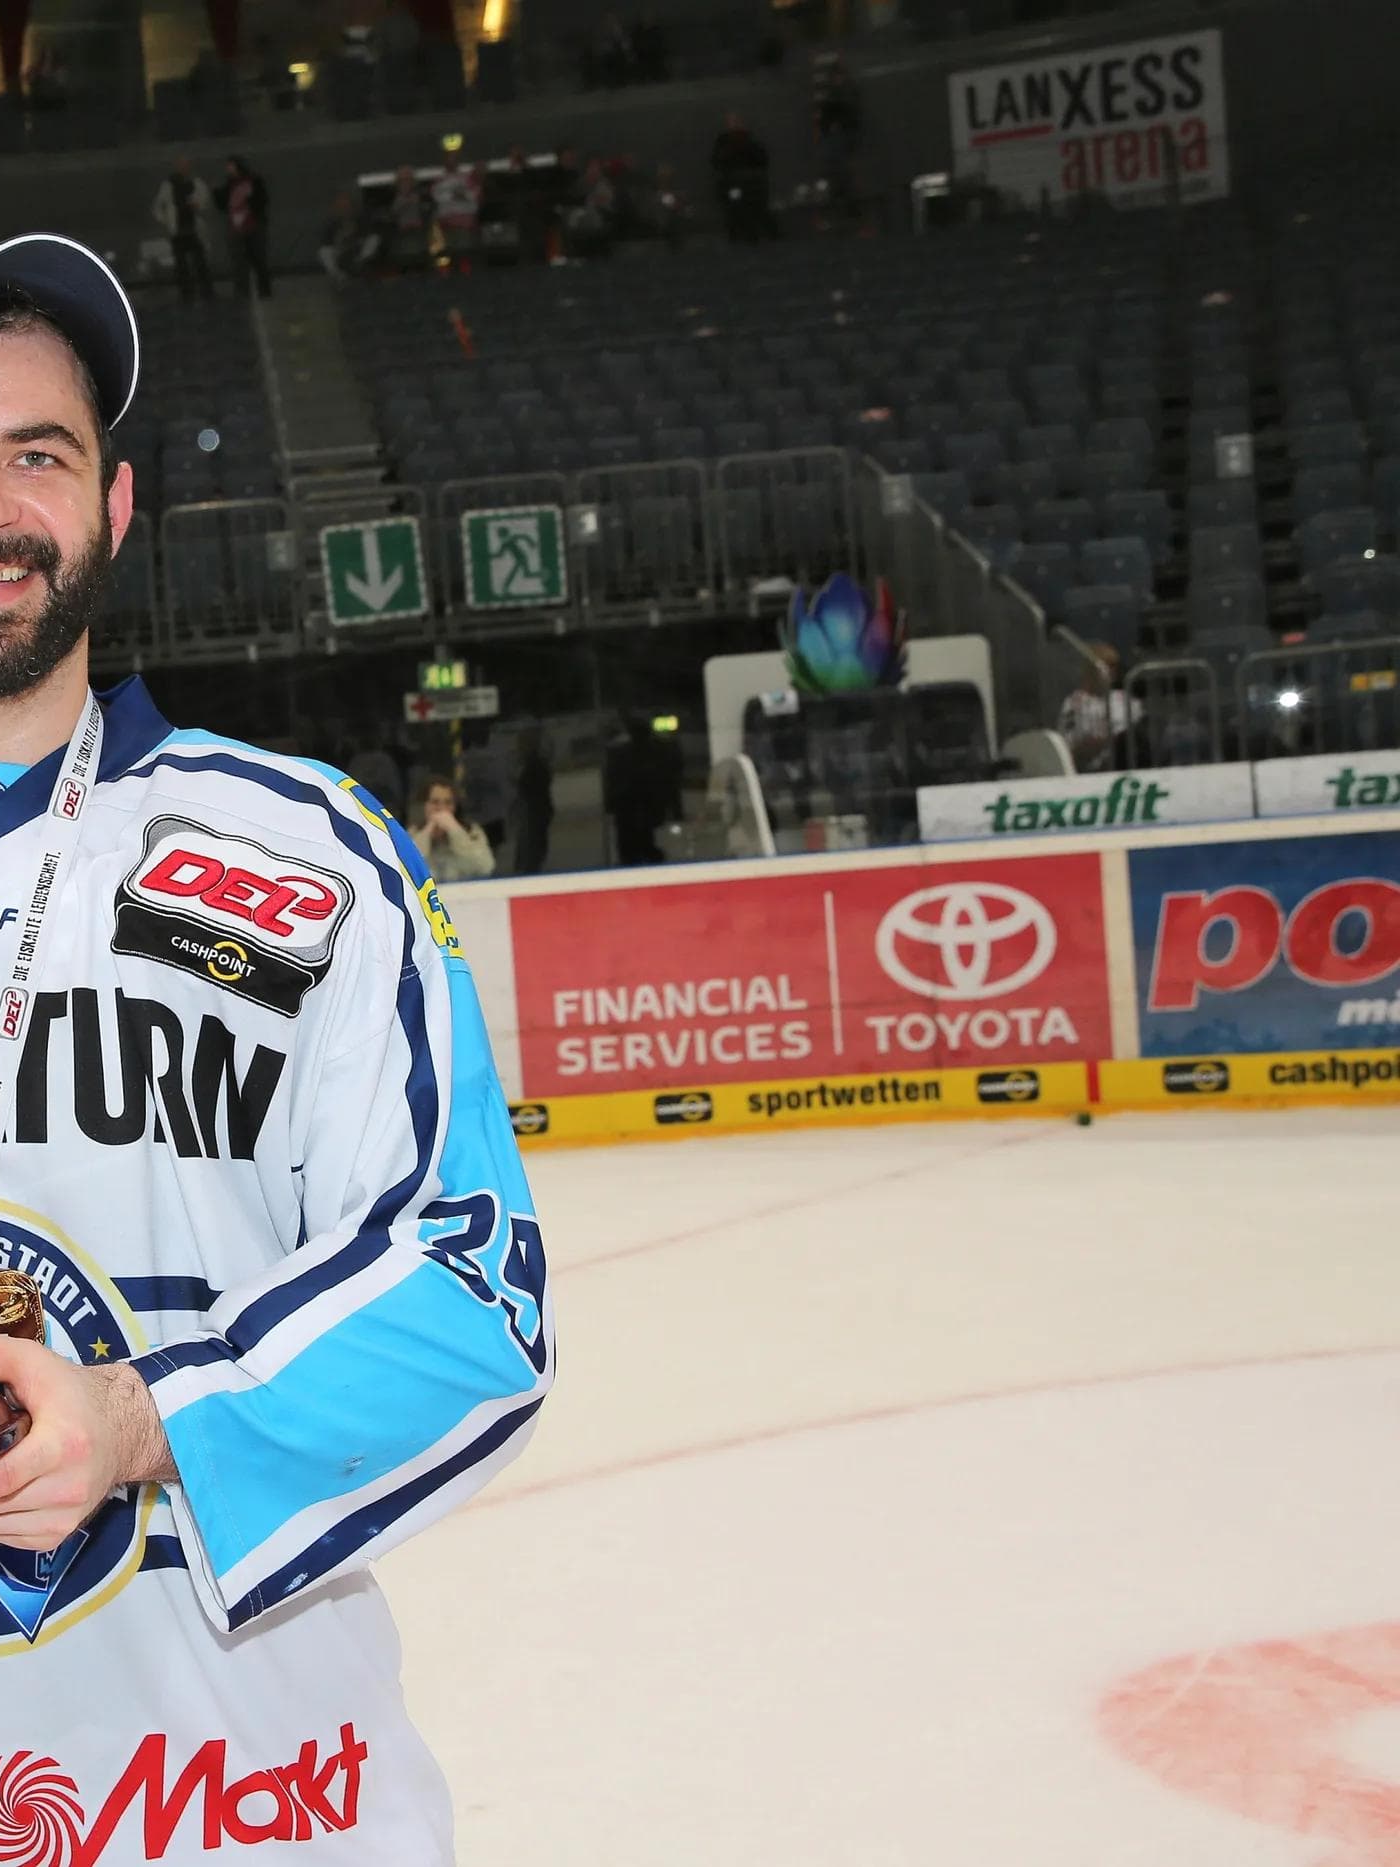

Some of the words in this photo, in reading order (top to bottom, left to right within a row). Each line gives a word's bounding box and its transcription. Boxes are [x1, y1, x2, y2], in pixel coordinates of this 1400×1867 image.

[967, 46, 1204, 129] LANXESS
[1058, 117, 1209, 193] arena
[63, 781, 82, 818] DEL
[984, 770, 1169, 833] taxofit
[31, 851, 62, 915] LEIDENSCHAFT.
[139, 848, 338, 938] DEL
[17, 917, 44, 962] EISKALTE
[170, 935, 257, 977] CASHPOINT
[13, 965, 30, 981] DIE
[2, 990, 23, 1037] DEL
[553, 974, 809, 1028] FINANCIAL
[556, 1020, 813, 1076] SERVICES
[864, 1006, 1080, 1055] TOYOTA
[748, 1077, 942, 1118] sportwetten
